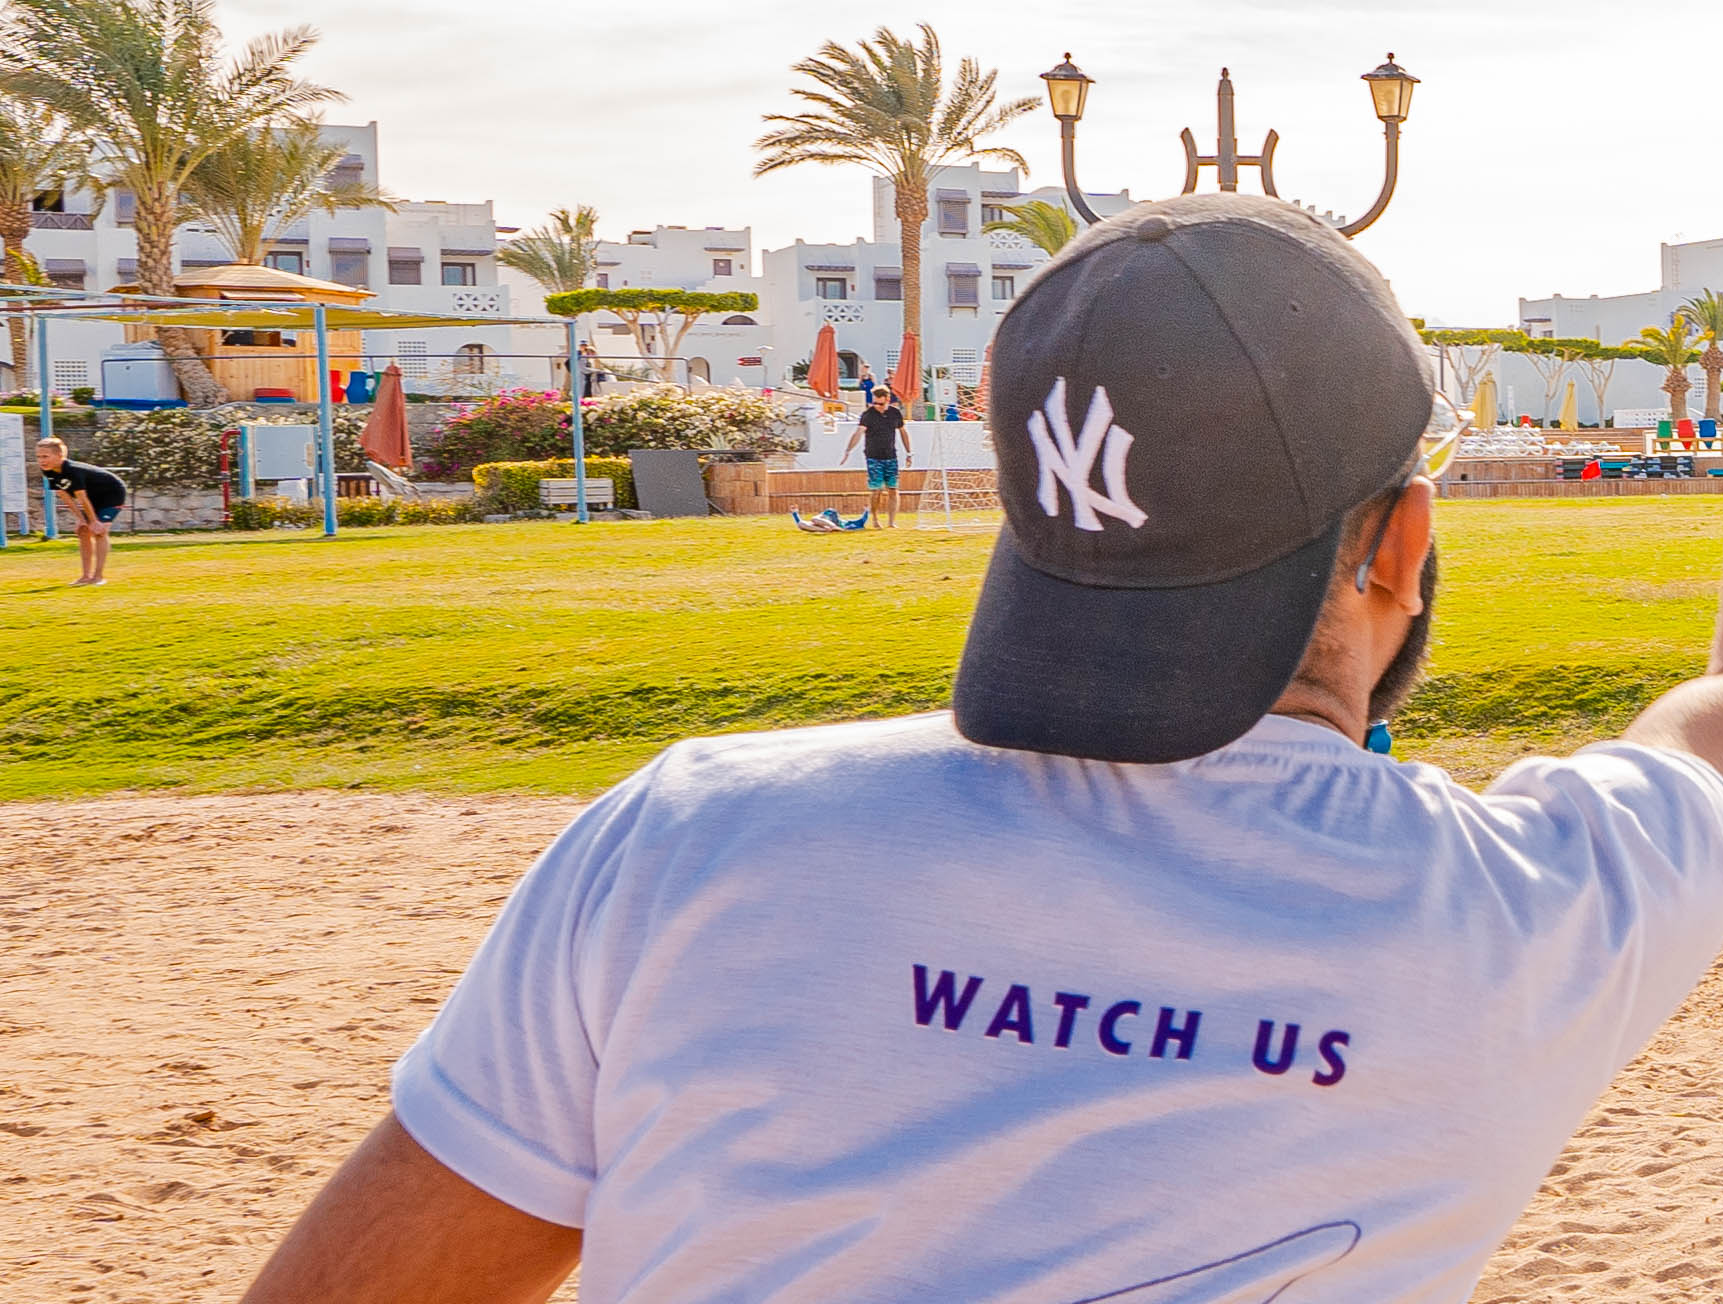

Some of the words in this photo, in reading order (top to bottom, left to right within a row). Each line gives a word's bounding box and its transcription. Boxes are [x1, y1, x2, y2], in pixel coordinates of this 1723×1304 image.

[1026, 375, 1149, 532] NY
[912, 963, 1202, 1060] WATCH
[1251, 1019, 1351, 1087] US
